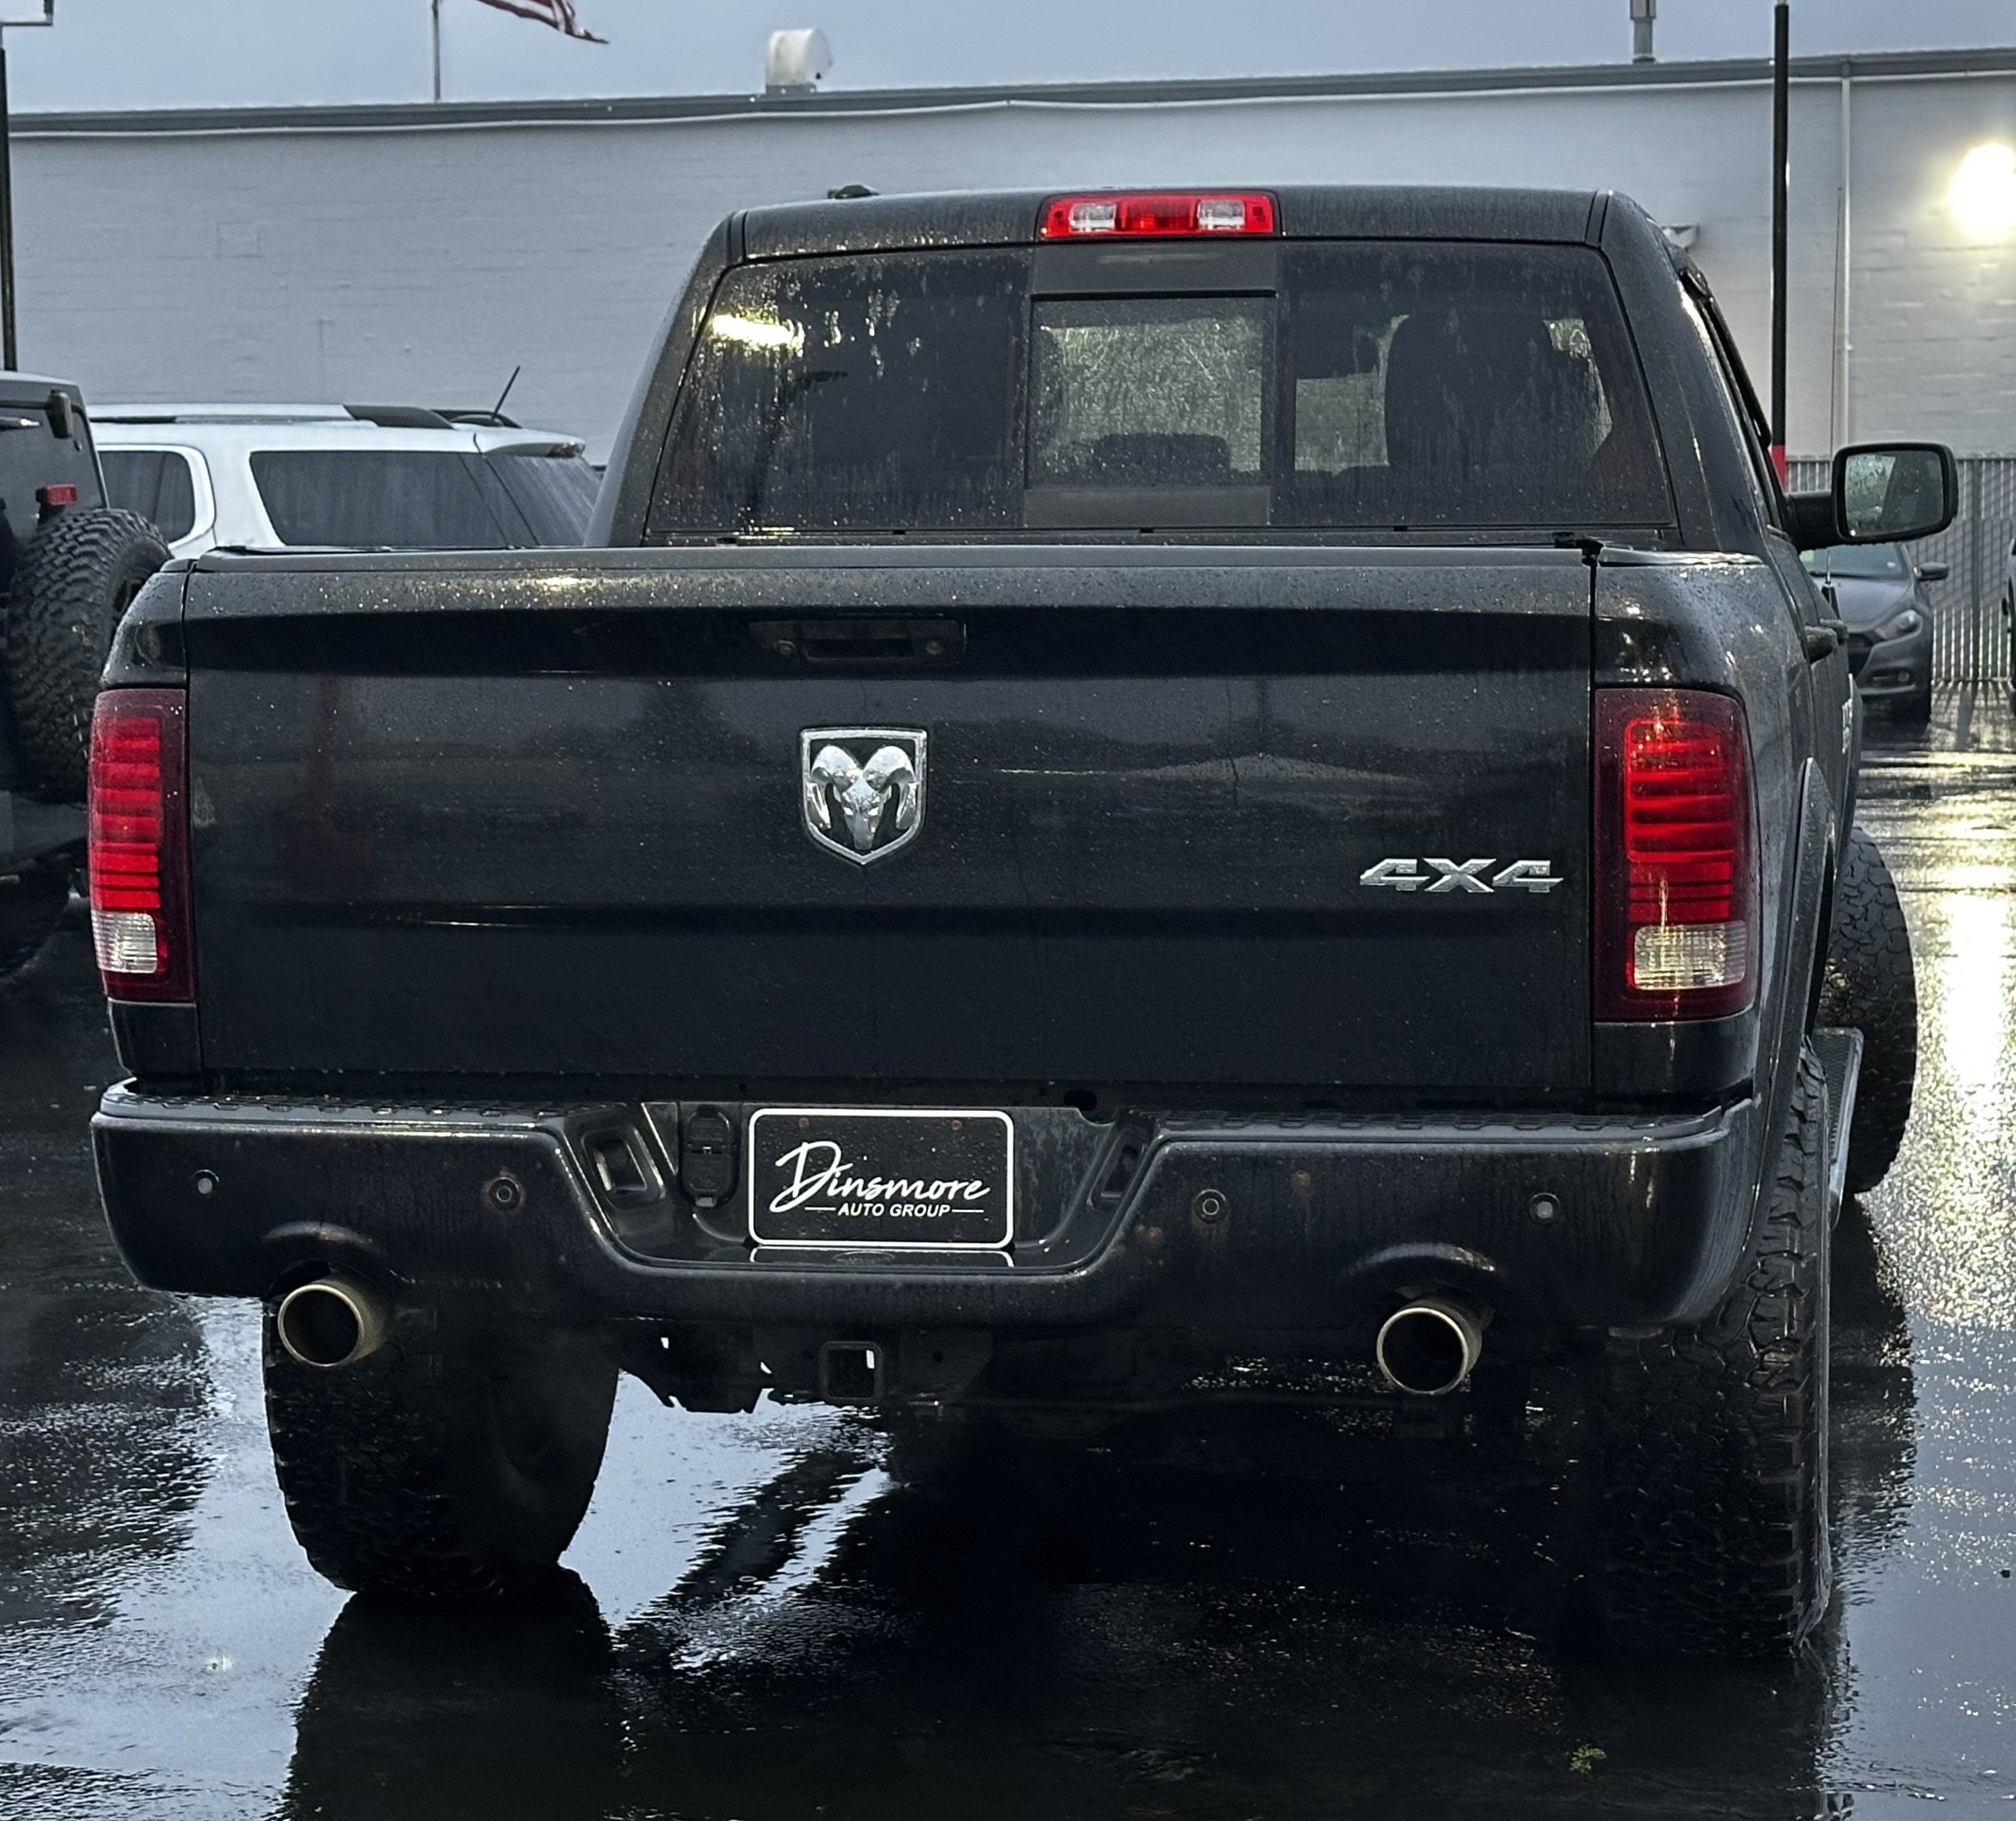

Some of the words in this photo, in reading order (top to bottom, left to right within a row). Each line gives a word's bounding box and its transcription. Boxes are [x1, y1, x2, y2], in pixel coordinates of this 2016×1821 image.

[1359, 857, 1564, 894] 4X4
[769, 1140, 991, 1213] Dinsmore
[837, 1202, 885, 1217] AUTO
[889, 1203, 951, 1218] GROUP
